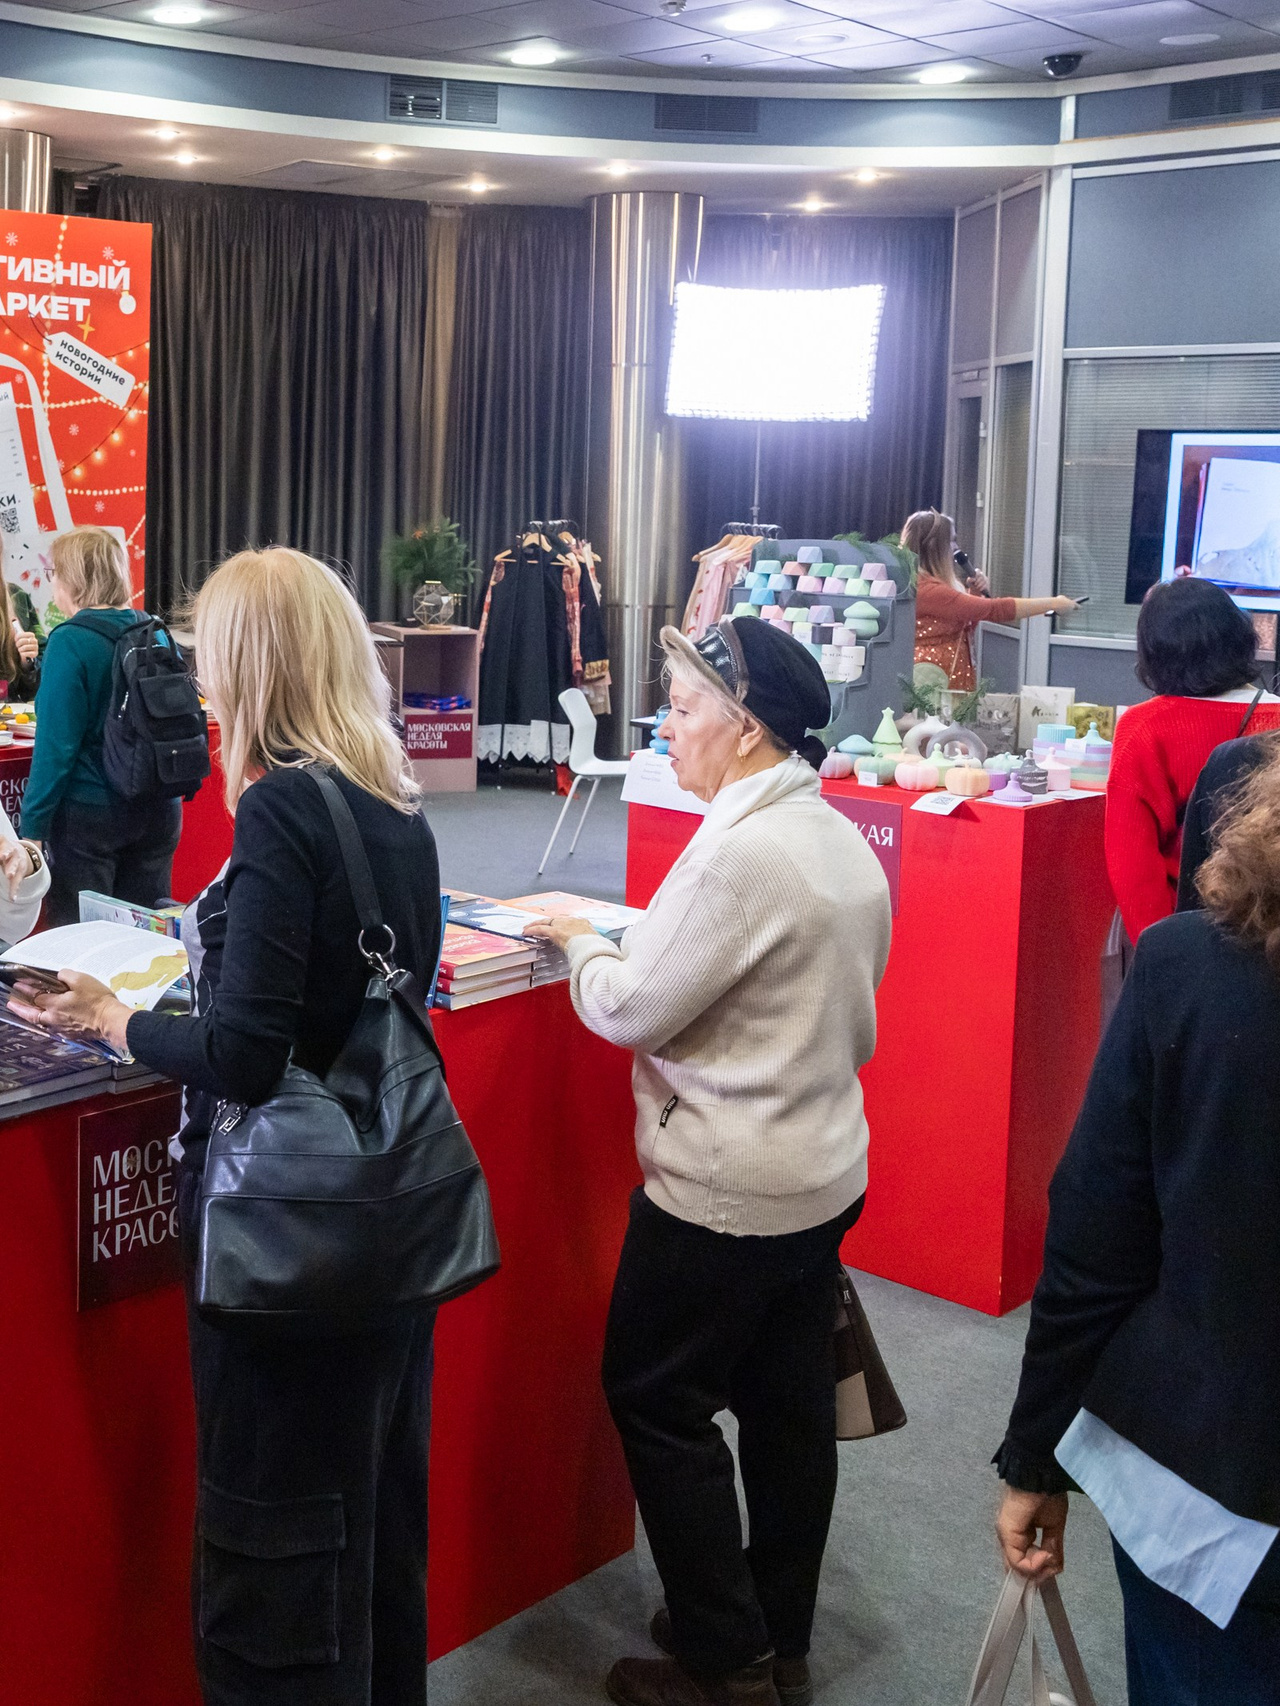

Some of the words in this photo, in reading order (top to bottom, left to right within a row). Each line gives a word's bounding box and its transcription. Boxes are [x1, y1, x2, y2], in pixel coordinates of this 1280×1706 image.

[407, 722, 471, 732] МОСКОВСКАЯ
[407, 731, 443, 741] НЕДЕЛЯ
[407, 740, 448, 750] КРАСОТЫ
[93, 1172, 177, 1225] НЕДЕ
